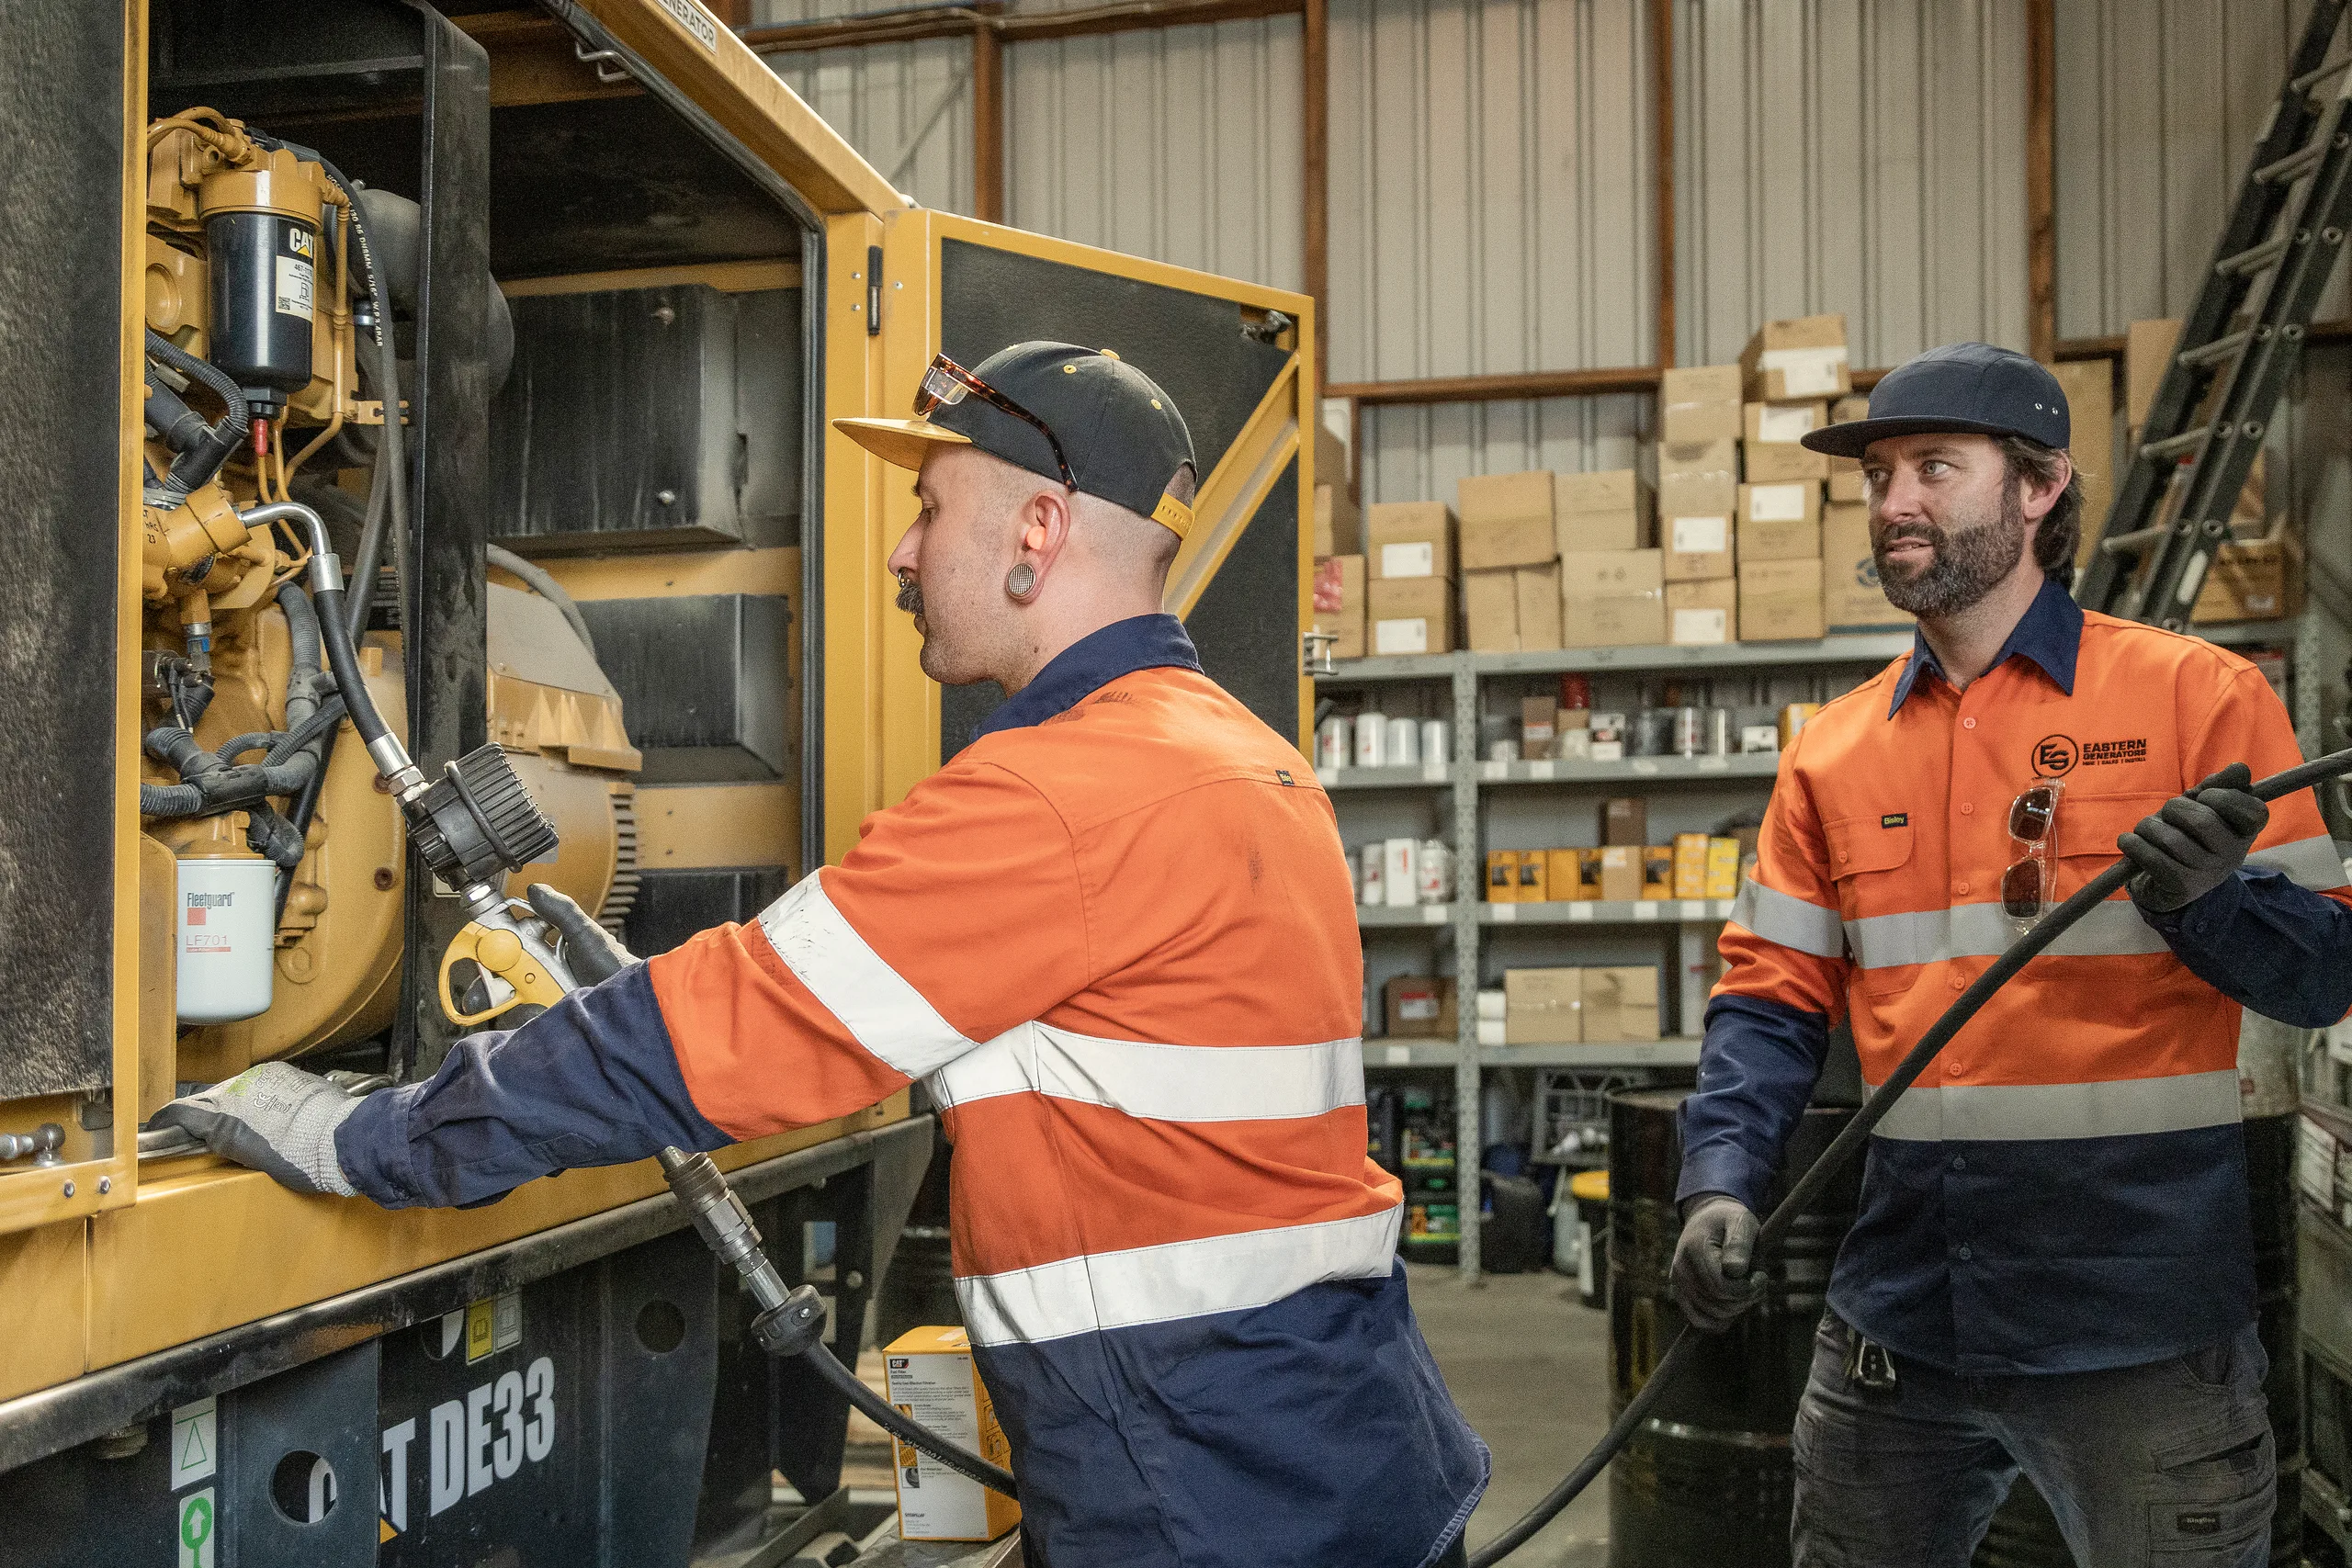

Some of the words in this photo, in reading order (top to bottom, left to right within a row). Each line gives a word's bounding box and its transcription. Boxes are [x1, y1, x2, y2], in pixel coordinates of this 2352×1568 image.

[2083, 739, 2147, 753] EASTERN
[2083, 749, 2147, 761] GENERATORS
[187, 892, 232, 909] Fleetguard
[187, 934, 227, 946] LF701
[431, 1356, 555, 1517] DE33
